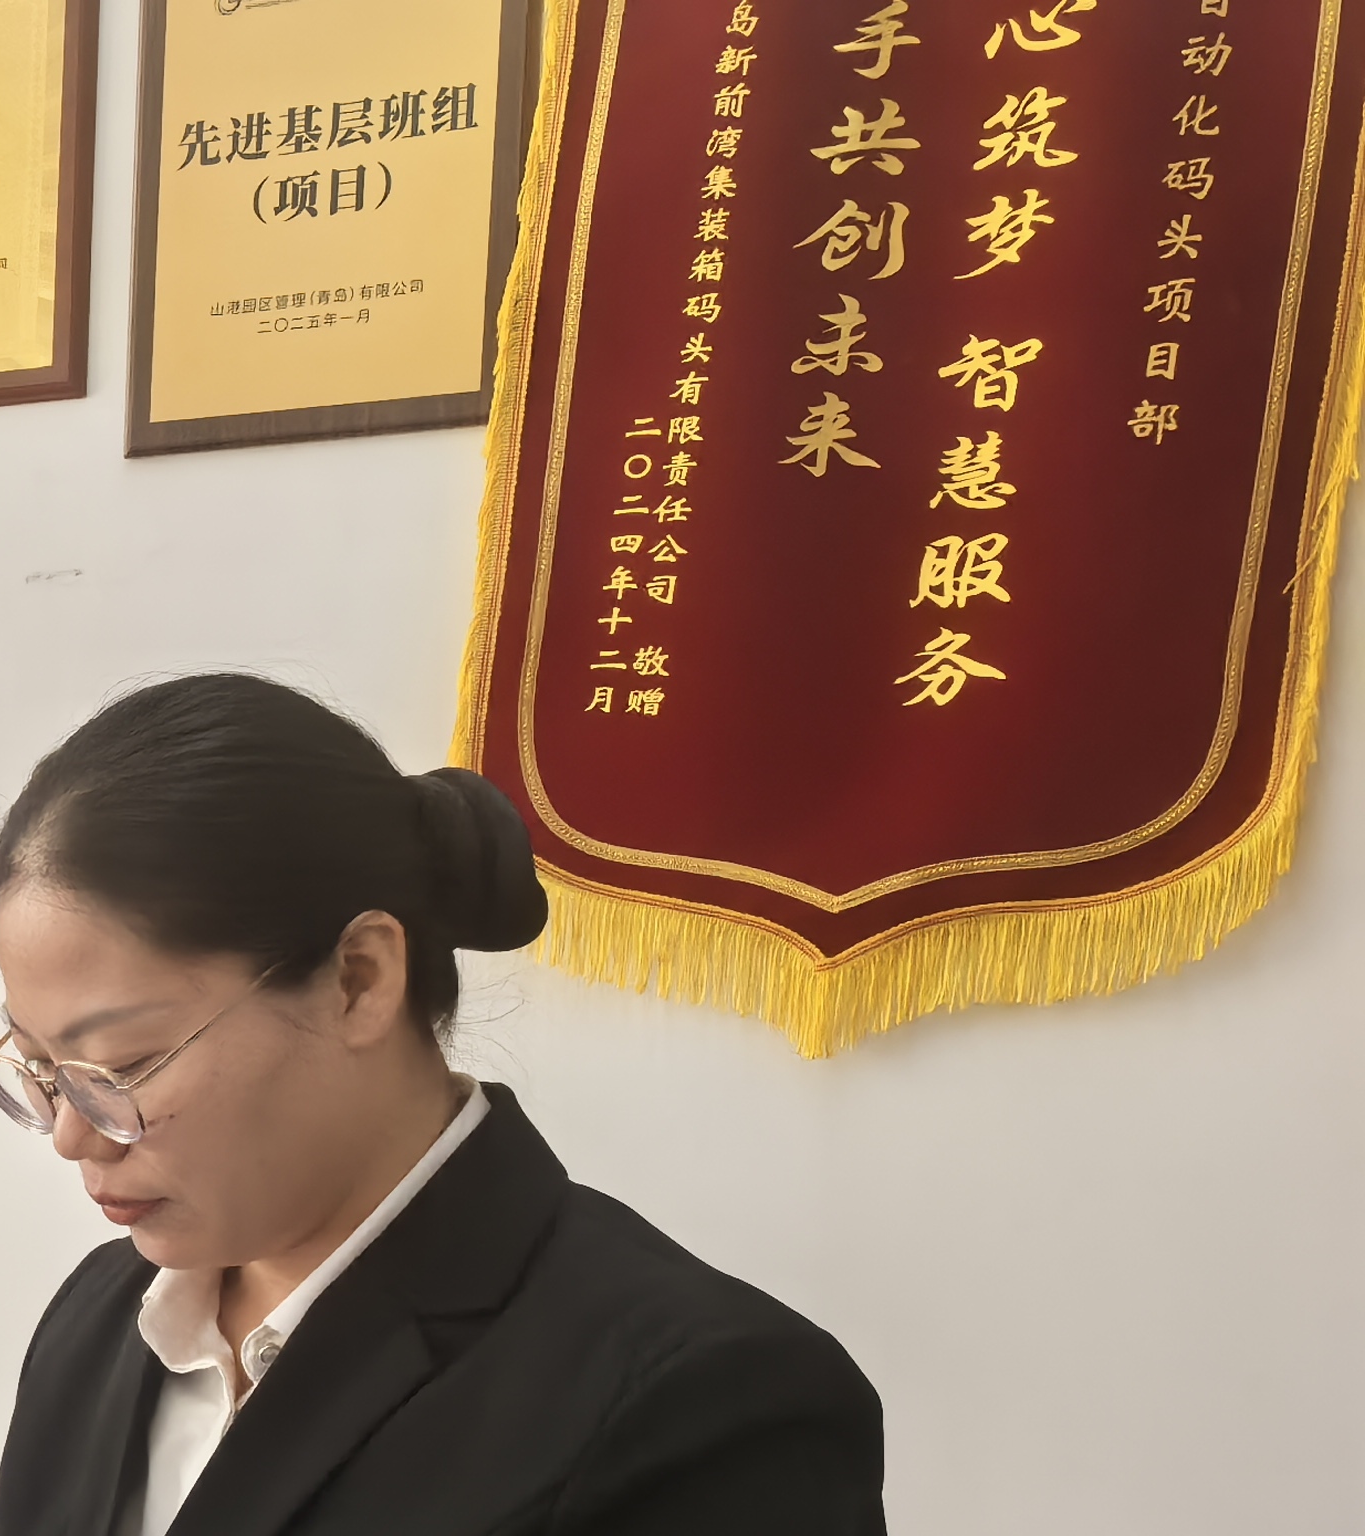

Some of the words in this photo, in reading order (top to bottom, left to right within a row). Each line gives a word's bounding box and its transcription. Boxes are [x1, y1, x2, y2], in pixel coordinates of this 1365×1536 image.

[176, 82, 479, 171] 先进基层班组
[777, 0, 921, 478] 手共创未来
[893, 332, 1043, 708] 智慧服务
[623, 646, 670, 718] 敬赠
